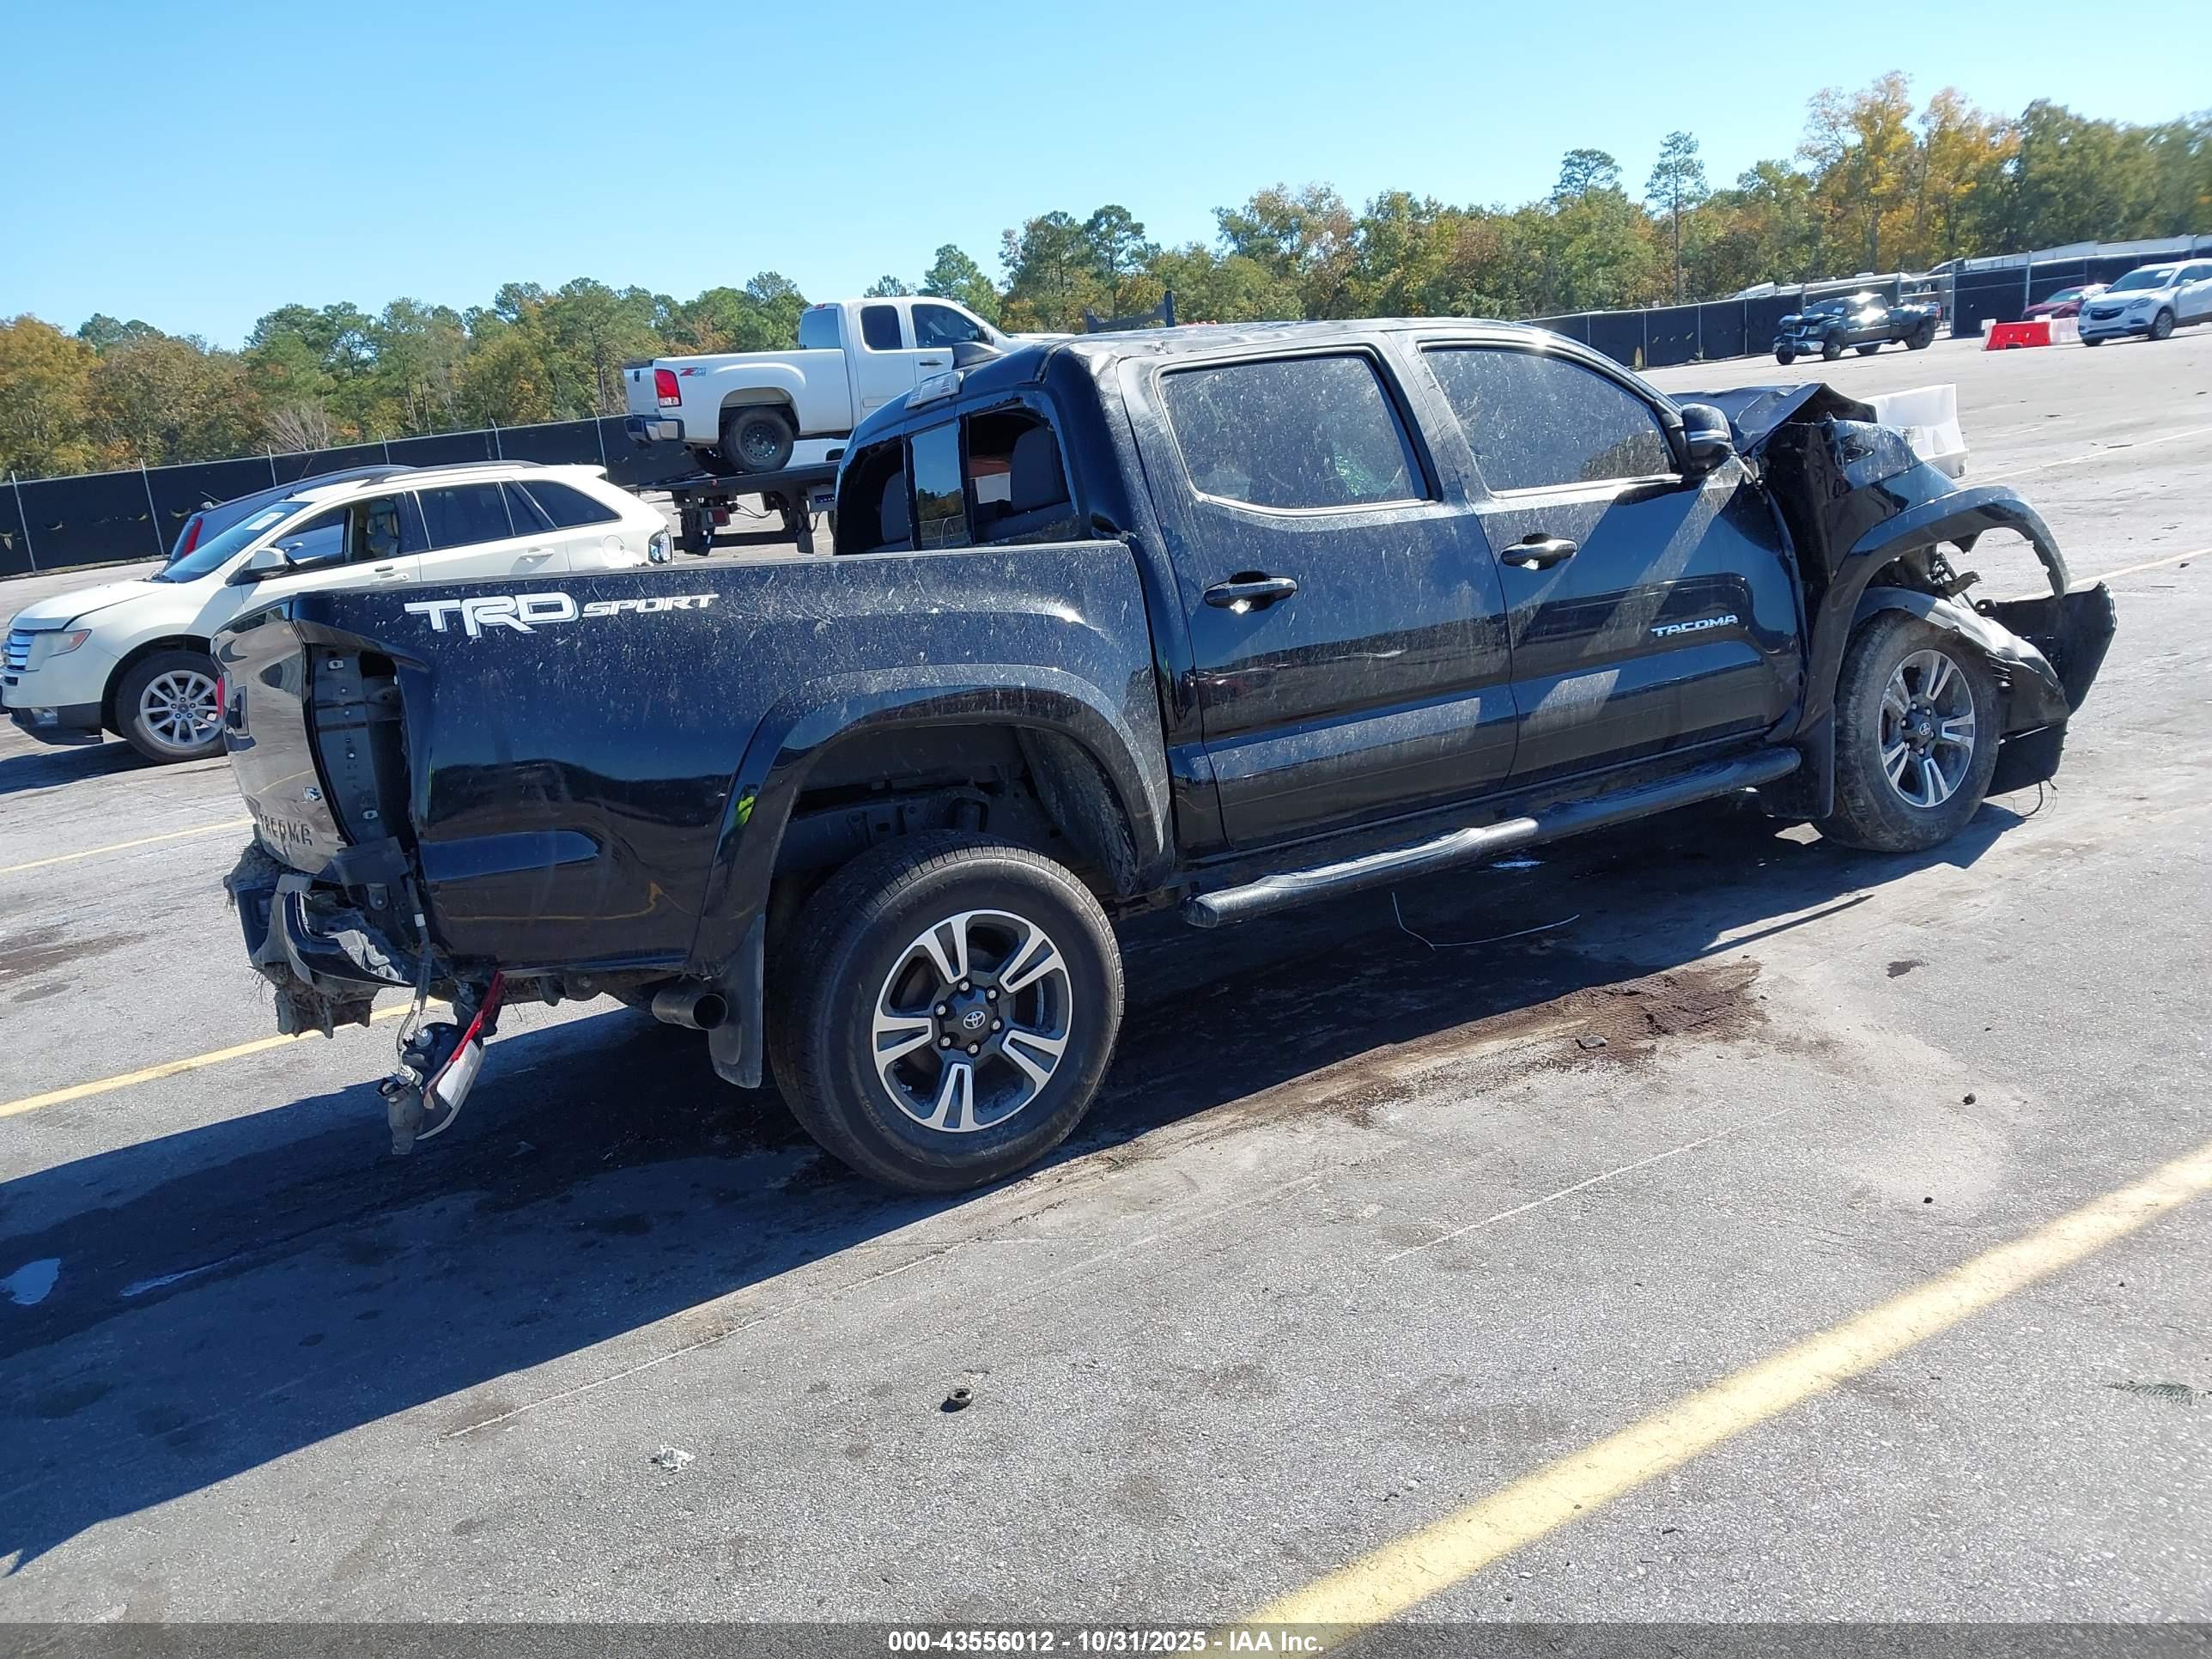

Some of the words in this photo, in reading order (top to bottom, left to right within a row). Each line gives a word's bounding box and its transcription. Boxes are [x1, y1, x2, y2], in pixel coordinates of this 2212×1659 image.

[404, 592, 579, 638] TRD
[582, 593, 720, 617] SPORT
[1650, 614, 1739, 637] TACOMA
